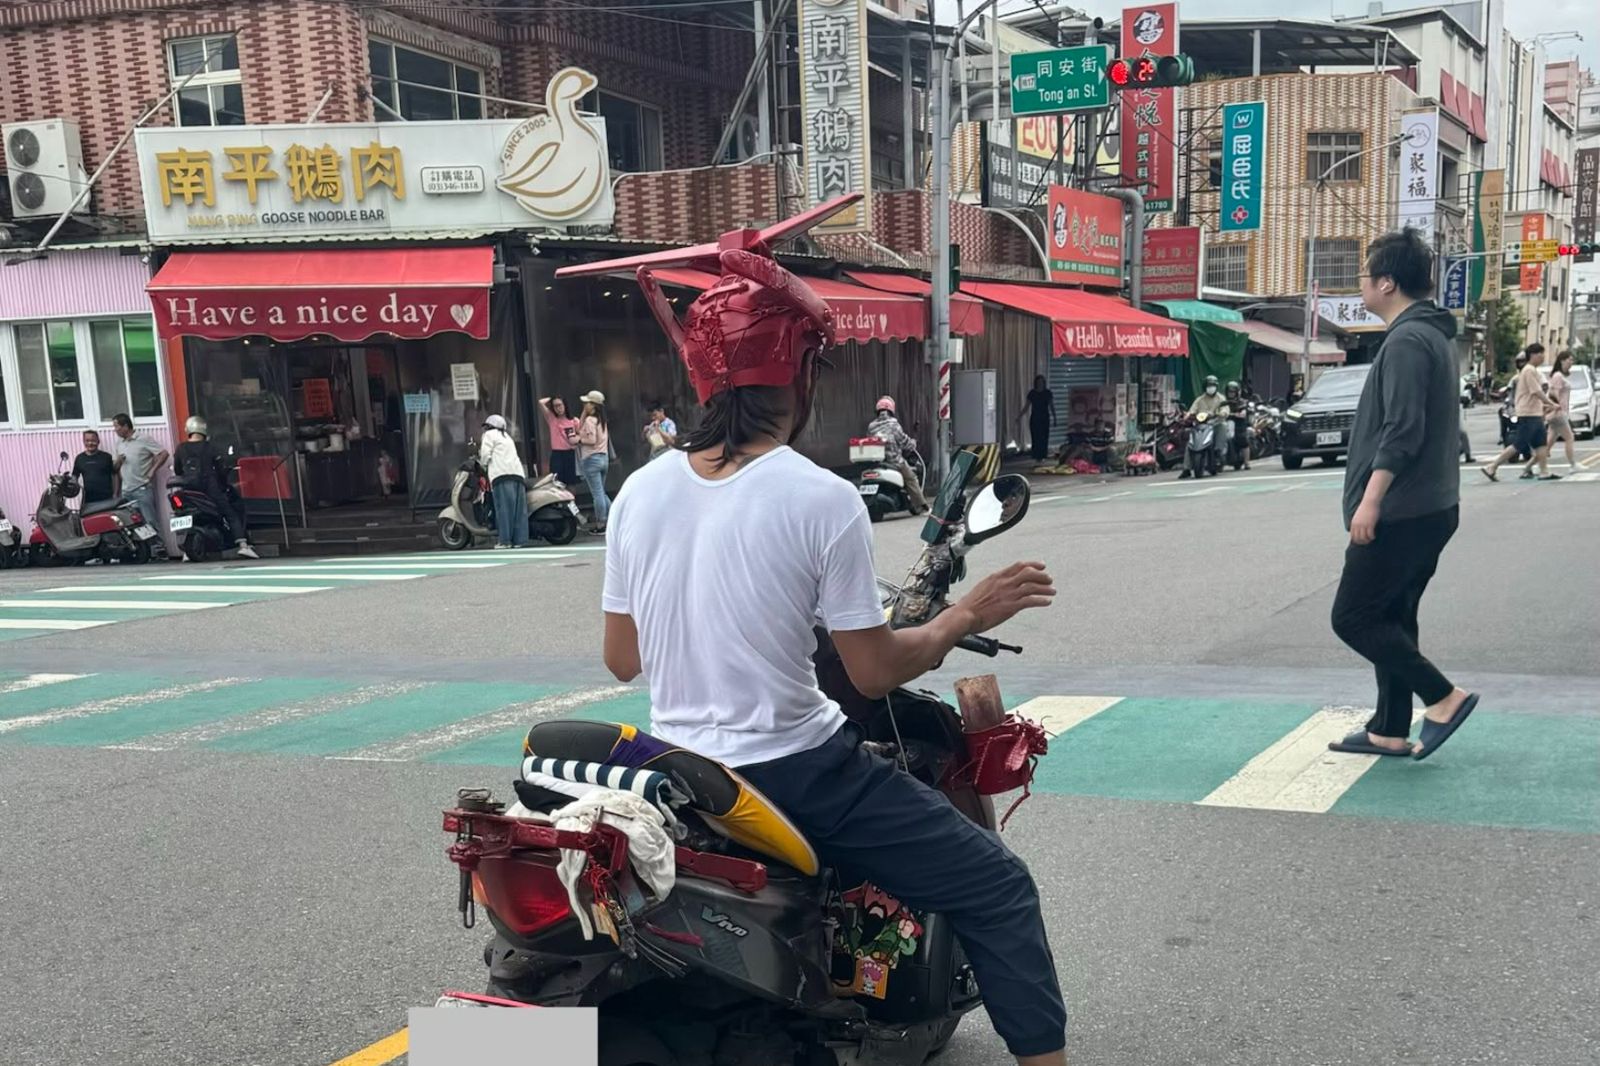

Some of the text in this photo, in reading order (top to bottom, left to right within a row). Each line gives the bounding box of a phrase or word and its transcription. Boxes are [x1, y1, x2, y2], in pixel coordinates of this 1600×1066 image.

[1037, 56, 1096, 78] 同安街
[810, 14, 851, 201] 南平鵝肉
[1038, 84, 1098, 104] Tong'an St.
[504, 117, 546, 161] SINCE 2005
[154, 141, 407, 209] 南平鵝肉
[1231, 134, 1252, 200] 屈臣氏
[1407, 152, 1427, 198] 聚福
[261, 211, 306, 225] GOOSE
[308, 209, 358, 224] NOODLE
[360, 208, 385, 221] BAR
[166, 293, 438, 332] Have a nice day
[832, 305, 876, 337] ice day
[1075, 325, 1104, 349] Hello
[1106, 325, 1112, 350] !
[1113, 325, 1155, 349] beautiful
